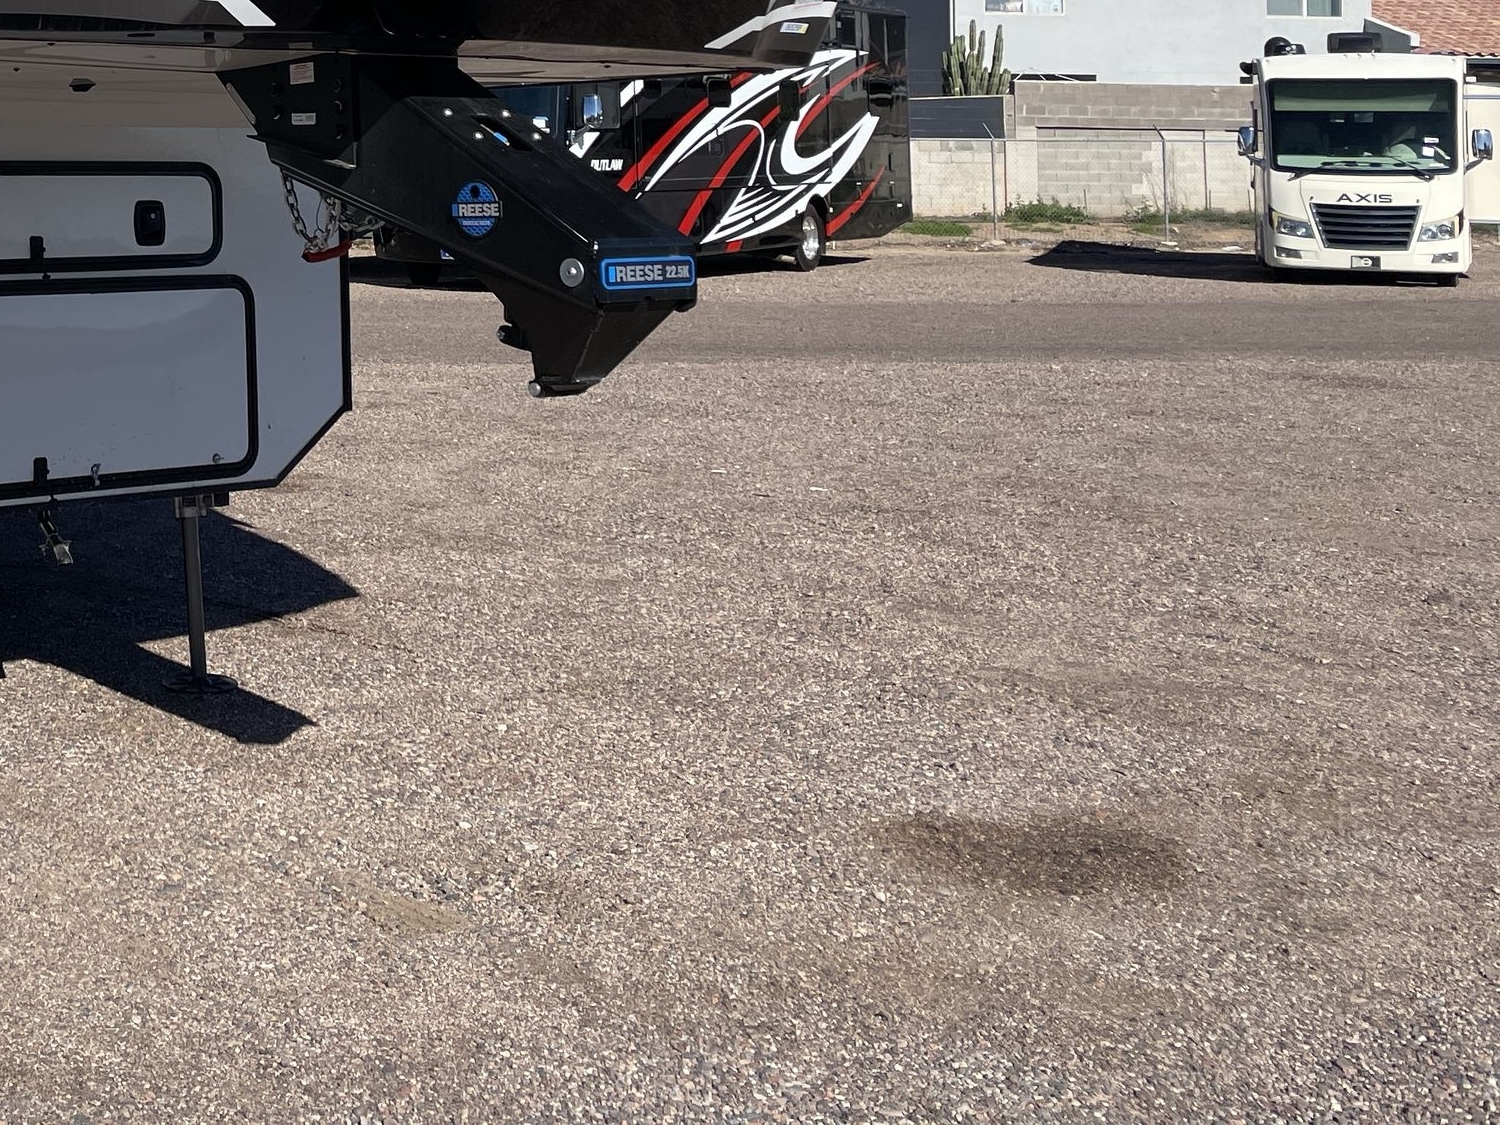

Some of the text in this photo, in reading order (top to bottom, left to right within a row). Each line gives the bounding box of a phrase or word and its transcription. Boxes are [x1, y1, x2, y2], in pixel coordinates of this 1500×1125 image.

[591, 159, 624, 172] OUTLAW
[1336, 193, 1393, 203] AXIS
[458, 203, 500, 217] REESE
[615, 264, 691, 282] REESE 22.5K
